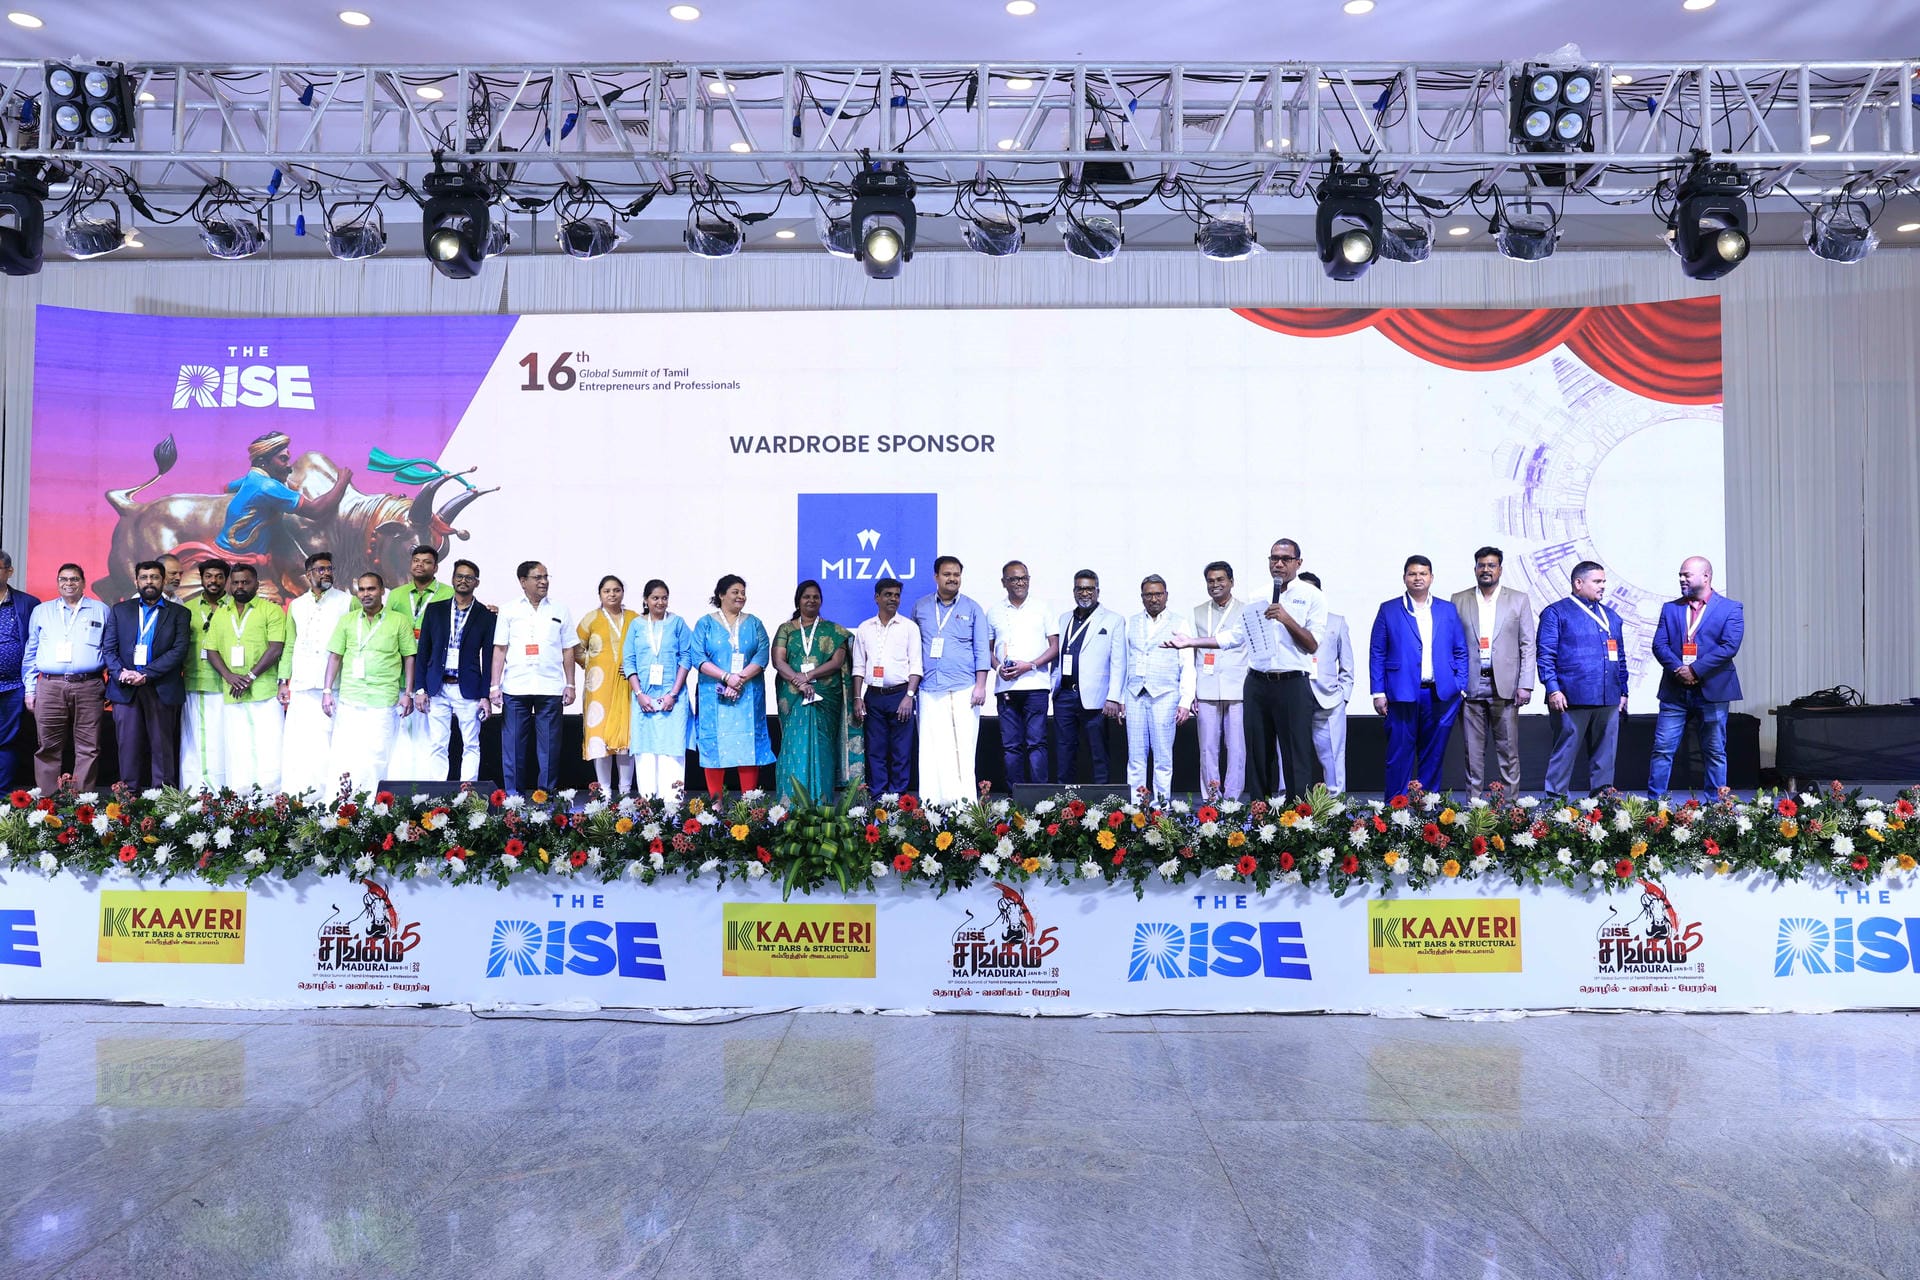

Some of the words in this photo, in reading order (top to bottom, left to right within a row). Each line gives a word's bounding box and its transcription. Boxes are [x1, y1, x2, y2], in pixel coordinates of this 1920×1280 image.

[228, 346, 268, 357] THE
[579, 369, 610, 378] Global
[612, 369, 648, 378] Summit
[650, 368, 662, 378] of
[663, 368, 689, 377] Tamil
[172, 365, 315, 410] RISE
[579, 381, 650, 392] Entrepreneurs
[652, 381, 671, 390] and
[674, 380, 741, 390] Professionals
[730, 435, 870, 453] WARDROBE
[877, 434, 995, 452] SPONSOR
[821, 557, 916, 579] MIZAJ
[552, 894, 604, 908] THE
[1194, 895, 1247, 909] THE
[1836, 890, 1890, 904] THE
[132, 907, 242, 930] KAAVERI
[323, 926, 351, 935] RISE
[757, 921, 871, 943] KAAVERI
[1402, 917, 1516, 938] KAAVERI
[1602, 928, 1630, 937] RISE
[400, 922, 421, 952] 5
[957, 932, 986, 941] RISE
[1038, 926, 1059, 959] 5
[1682, 922, 1703, 953] 5
[486, 920, 666, 981] RISE
[813, 945, 871, 953] STRUCTURAL
[1128, 921, 1312, 982] RISE
[318, 963, 333, 971] MA
[342, 963, 388, 971] MADURAI
[953, 969, 969, 977] MA
[978, 969, 1026, 977] MADURAI
[1599, 965, 1615, 973] MA
[1624, 965, 1672, 973] MADURAI
